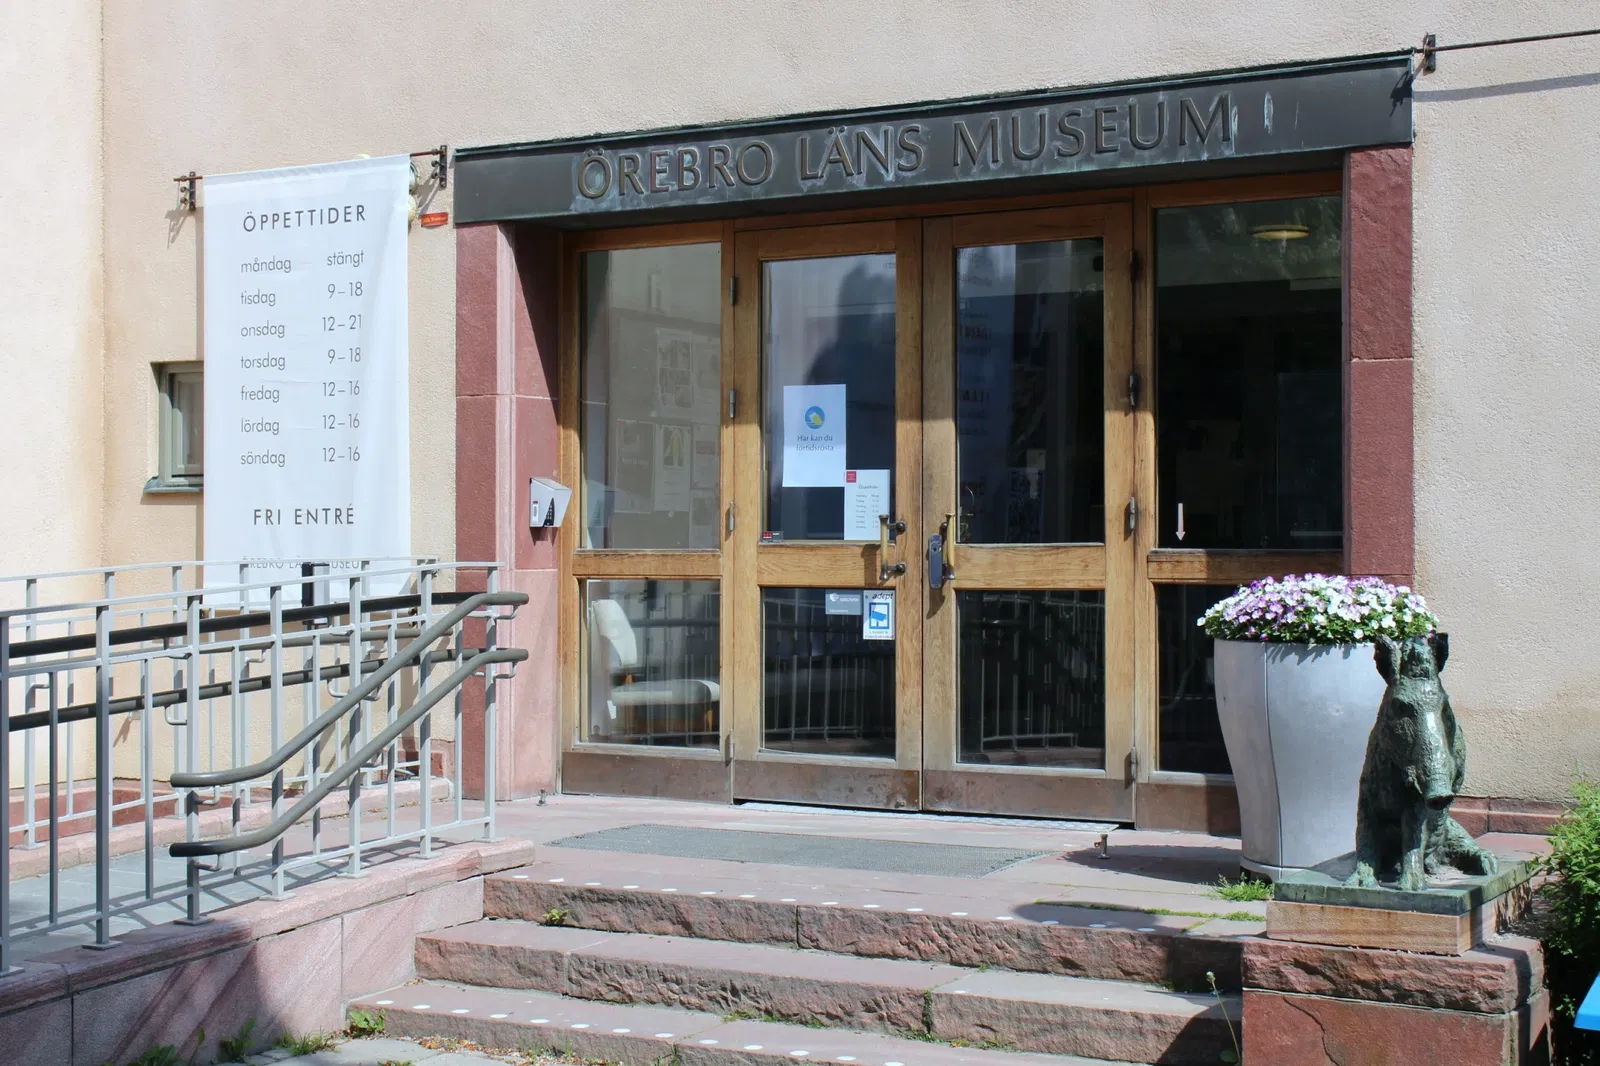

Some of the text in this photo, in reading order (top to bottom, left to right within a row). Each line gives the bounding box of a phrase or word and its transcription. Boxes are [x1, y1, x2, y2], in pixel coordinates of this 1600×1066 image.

[577, 94, 1231, 199] ÖREBRO LÄNS MUSEUM
[243, 204, 366, 232] ÖPPETTIDER
[240, 249, 365, 274] måndag stängt
[240, 289, 276, 307] tisdag
[240, 320, 286, 339] onsdag
[240, 353, 286, 371] torsdag
[240, 385, 280, 404] fredag
[240, 417, 280, 436] lördag
[240, 448, 286, 468] söndag
[253, 503, 355, 526] FRI ENTRÉ
